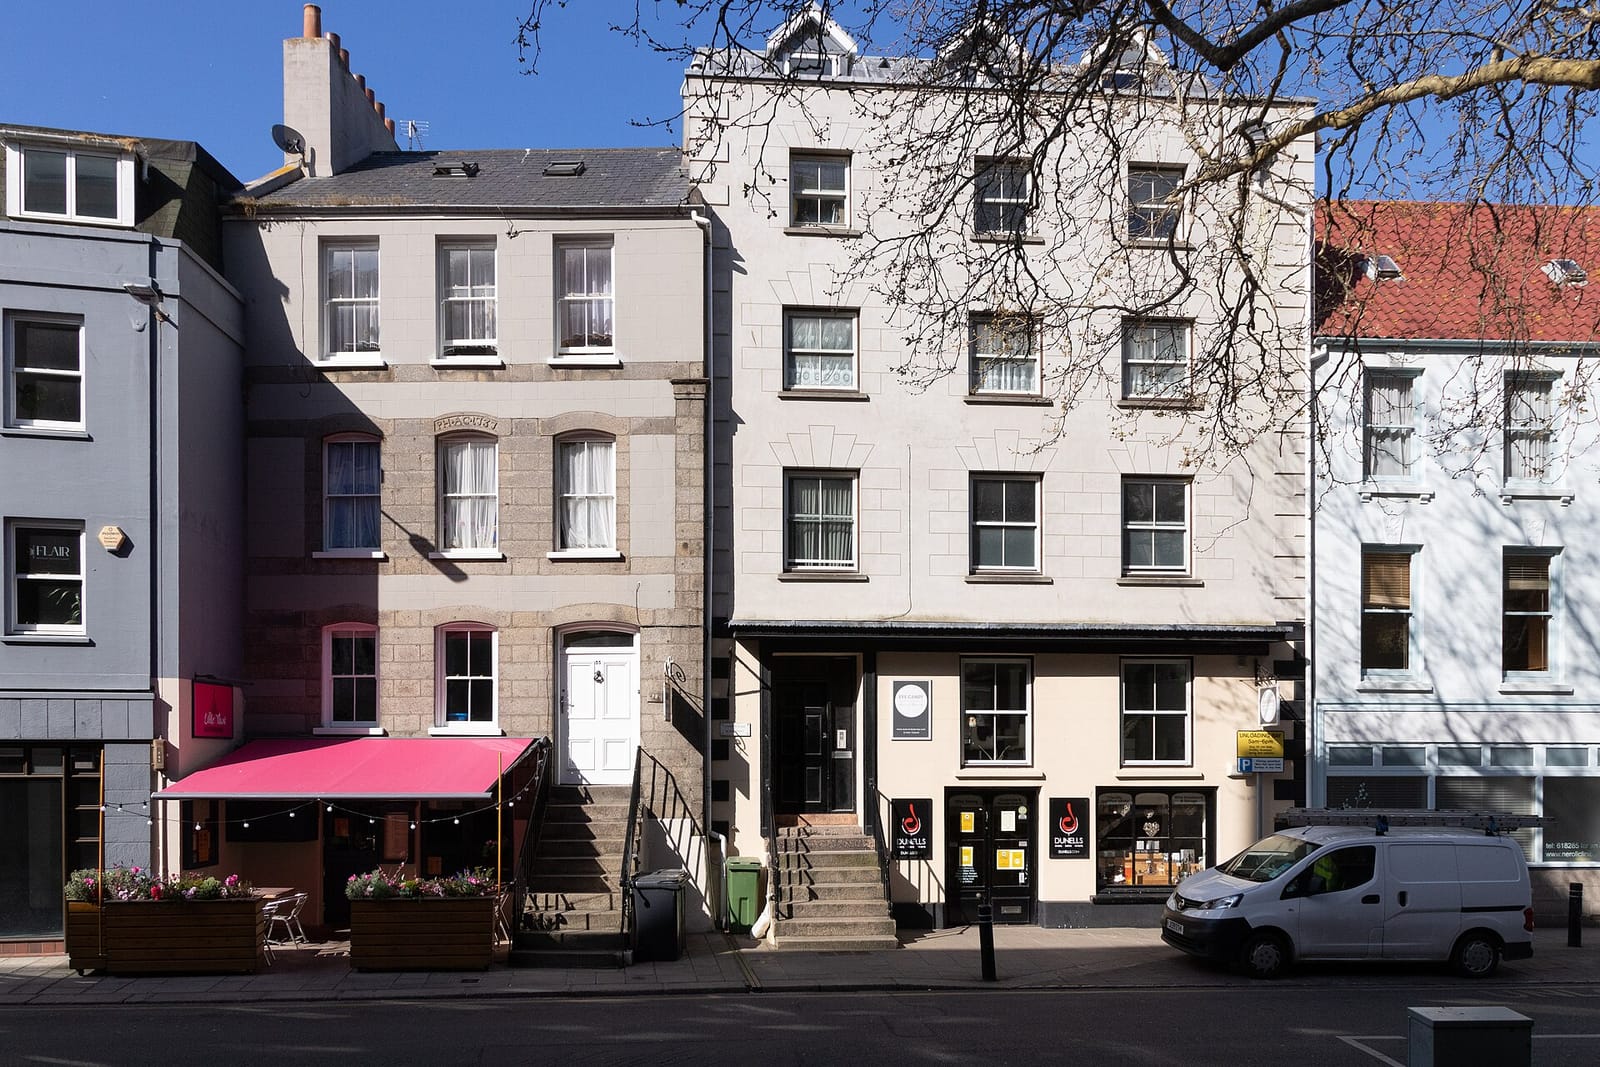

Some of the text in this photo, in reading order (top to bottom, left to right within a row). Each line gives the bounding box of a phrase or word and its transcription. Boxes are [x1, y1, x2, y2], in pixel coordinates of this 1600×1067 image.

[36, 545, 70, 557] FLAIR
[1242, 759, 1251, 771] P
[1054, 837, 1084, 845] DUNELLS
